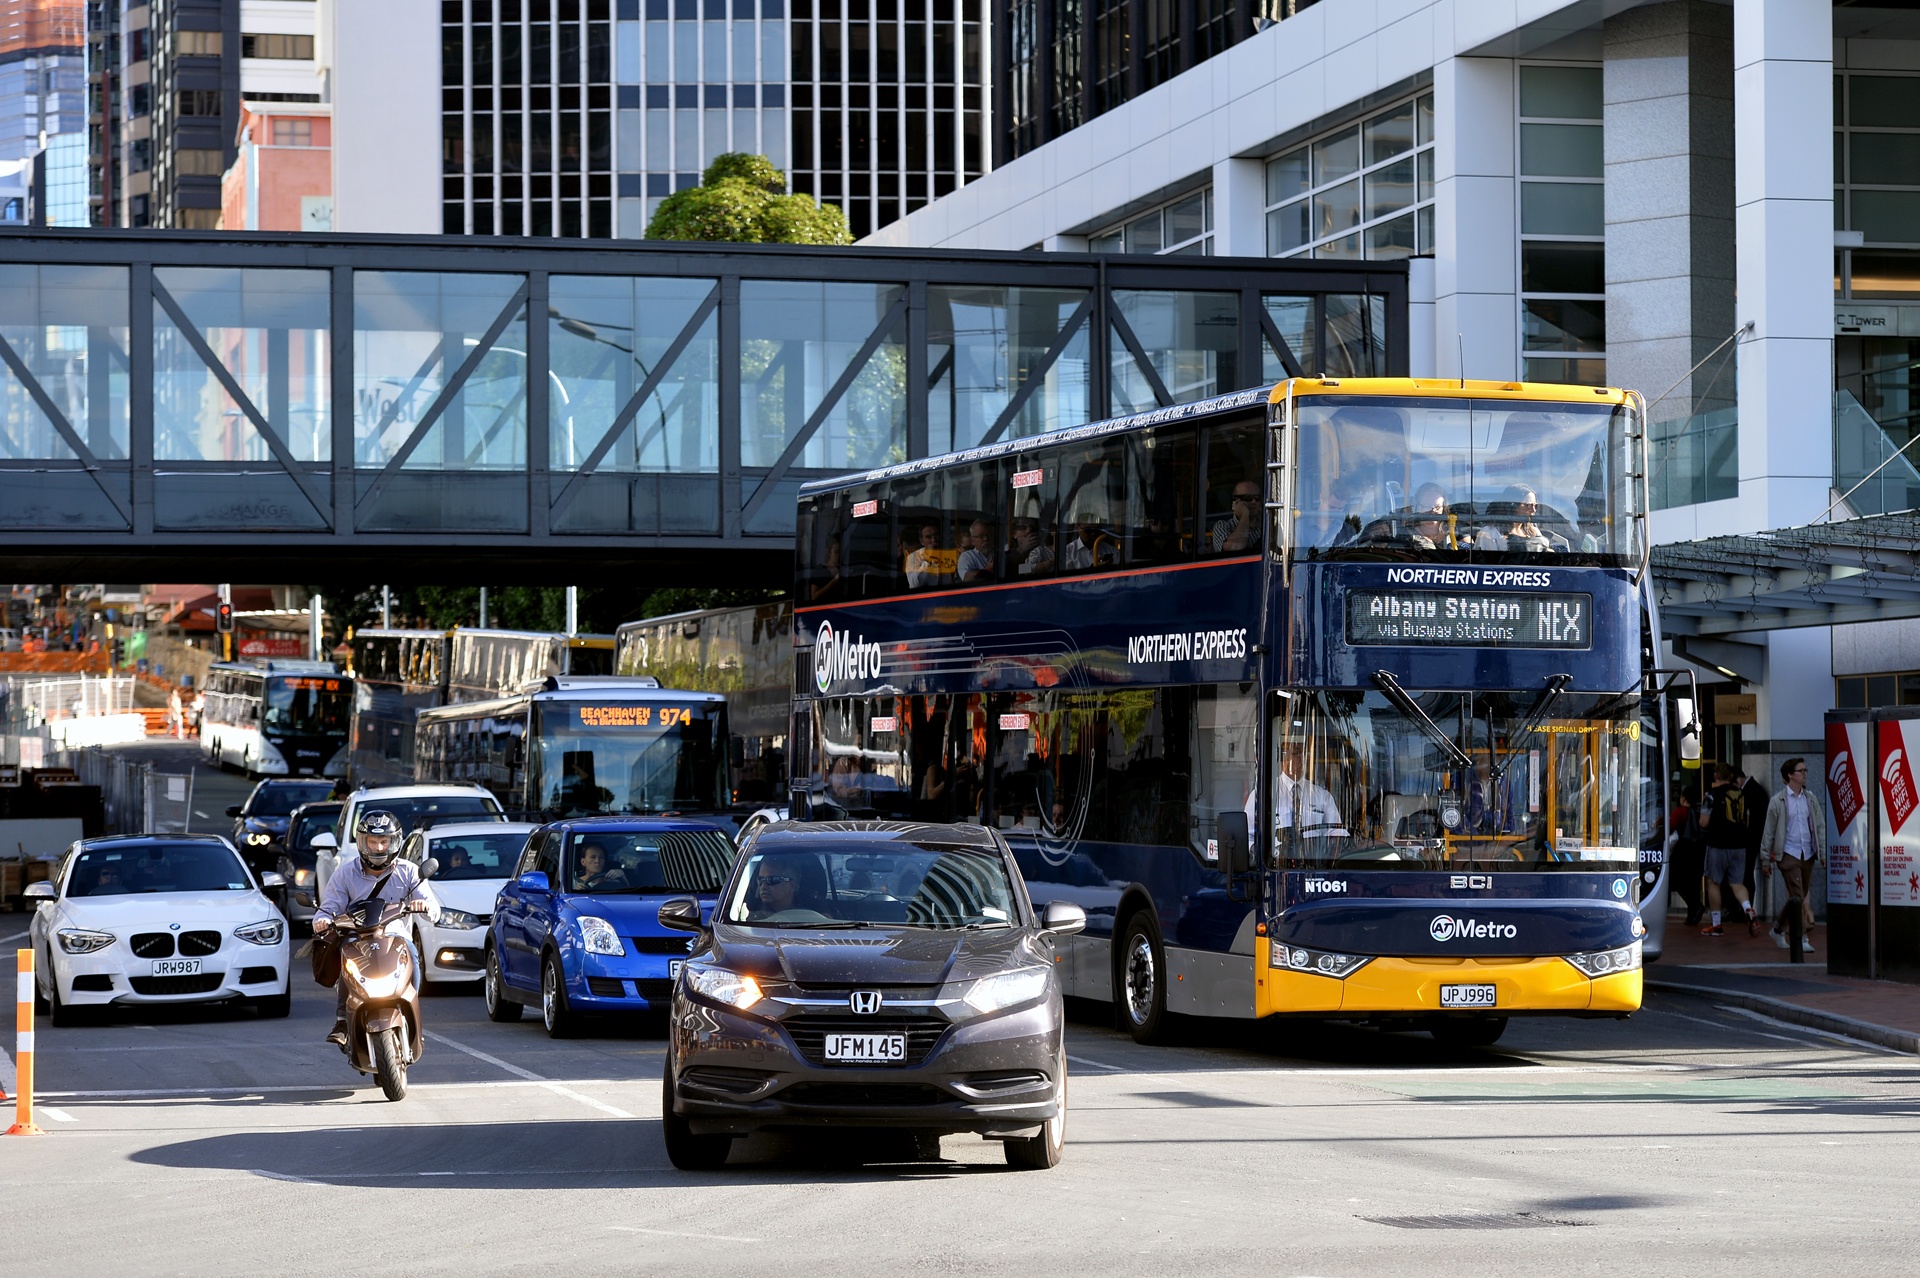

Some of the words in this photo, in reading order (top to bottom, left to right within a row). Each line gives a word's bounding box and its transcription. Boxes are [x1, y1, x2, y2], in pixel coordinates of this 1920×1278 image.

[1193, 398, 1218, 414] Hibiscus
[1217, 394, 1236, 410] Coast
[1234, 389, 1259, 406] Station
[1387, 568, 1478, 584] NORTHERN
[1482, 571, 1551, 587] EXPRESS
[1370, 596, 1437, 618] Albany
[1445, 598, 1521, 620] Station
[1378, 620, 1399, 637] via
[1403, 621, 1453, 639] Busway
[1456, 622, 1514, 640] Stations
[1538, 602, 1581, 641] NEX
[833, 630, 881, 680] Metro
[1128, 632, 1191, 664] NORTHERN
[1193, 628, 1247, 660] EXPRESS
[580, 707, 651, 718] BEACHHAVEN
[660, 708, 691, 726] 974
[1552, 725, 1578, 734] SIGNAL
[1614, 727, 1630, 735] STOP
[1838, 777, 1851, 800] FREE
[1891, 775, 1906, 799] FREE
[1843, 799, 1857, 822] ZONE
[1896, 799, 1911, 822] ZONE
[1639, 850, 1663, 863] BT83
[1830, 845, 1839, 854] 1GB
[1840, 846, 1850, 854] FREE
[1884, 846, 1892, 854] 1GB
[1893, 846, 1905, 854] FREE
[1305, 880, 1348, 893] N1061
[1450, 875, 1493, 889] BCI
[1455, 919, 1517, 938] Metro
[154, 961, 200, 974] JRW987
[1443, 988, 1494, 1002] JPJ996
[828, 1037, 903, 1057] JFM145
